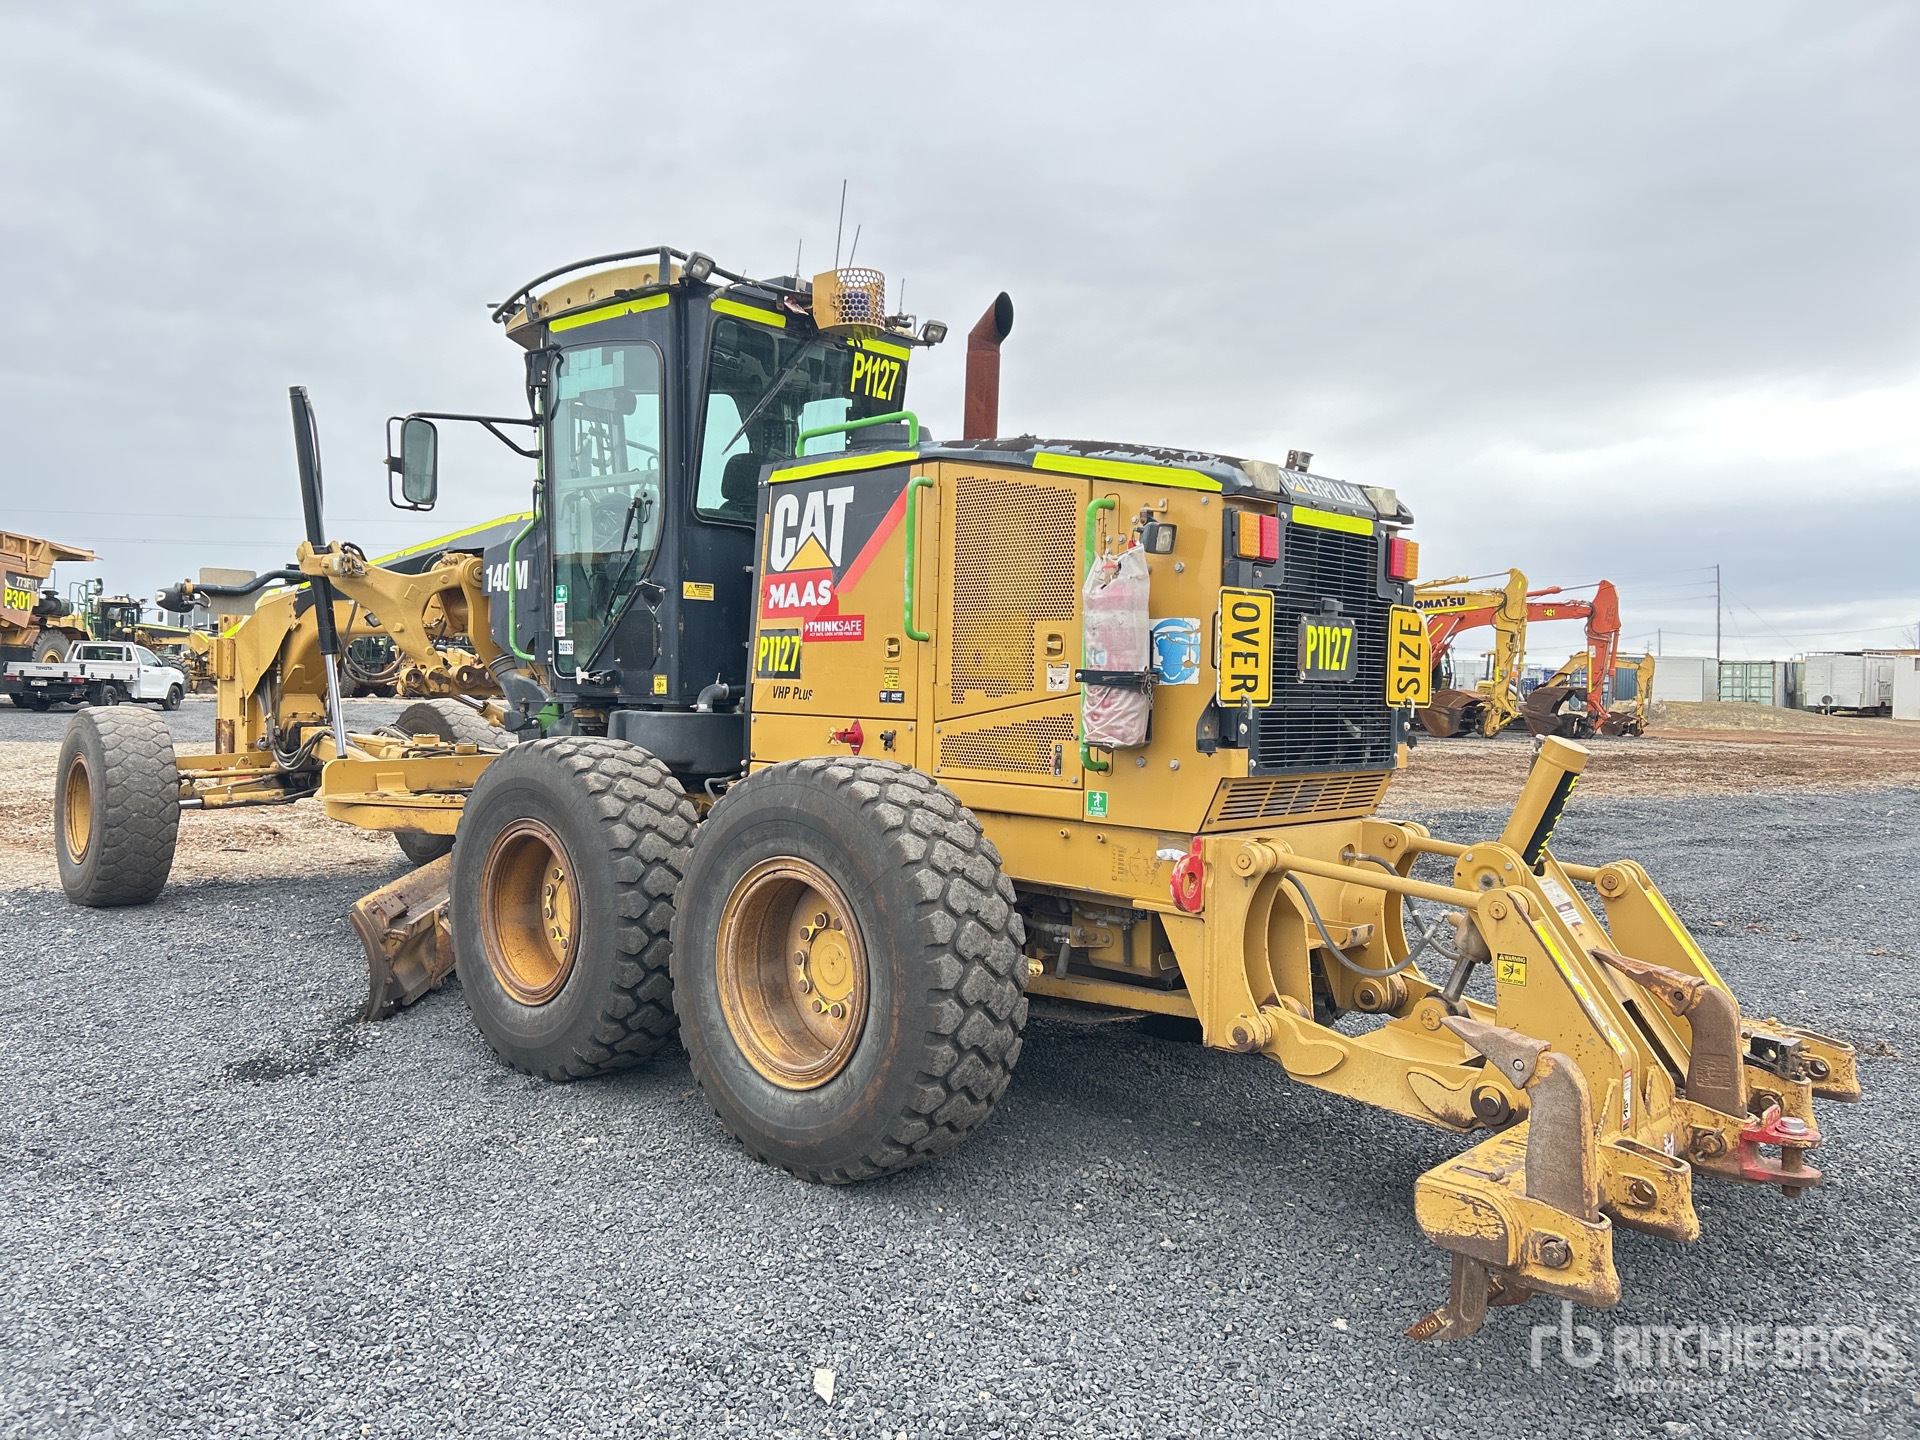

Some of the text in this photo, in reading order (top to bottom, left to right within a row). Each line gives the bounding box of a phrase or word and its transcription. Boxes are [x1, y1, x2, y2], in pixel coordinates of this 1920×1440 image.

[850, 351, 900, 401] P1127
[1280, 470, 1369, 507] CATERPILLAR
[770, 486, 855, 572] CAT
[485, 560, 529, 592] 140M
[4, 587, 31, 611] P301
[768, 580, 832, 609] MAAS
[1415, 595, 1466, 609] OMATSU
[808, 620, 862, 632] THINKSAFE
[757, 635, 800, 672] P1127
[1230, 602, 1261, 693] OVER
[1306, 625, 1352, 671] P1127
[1396, 619, 1422, 695] SIZE
[773, 685, 790, 699] VHP
[1504, 954, 1526, 963] WARNING
